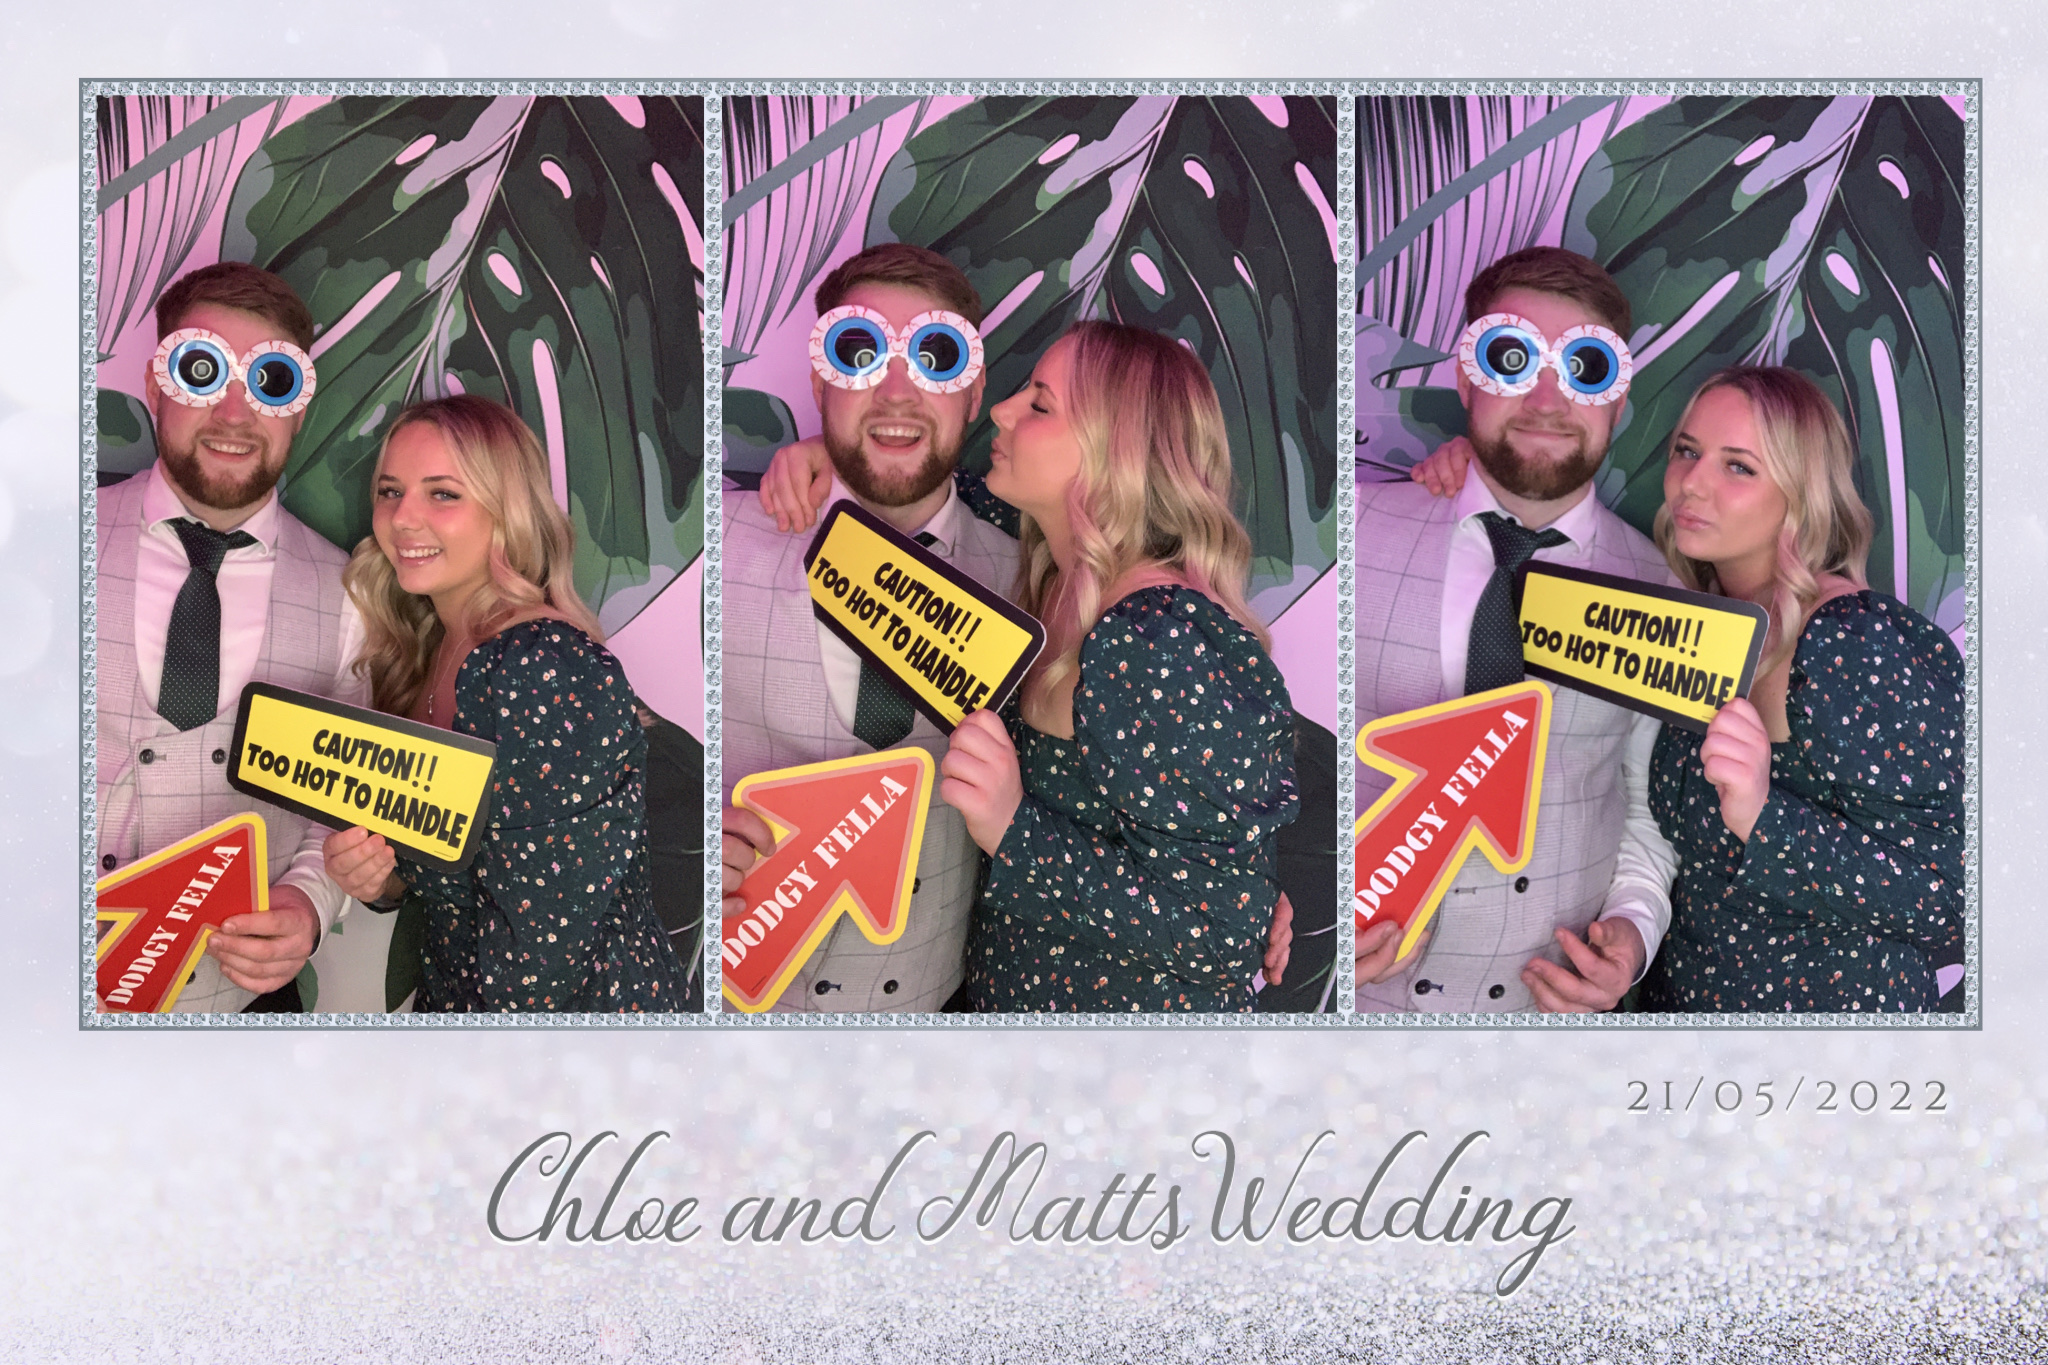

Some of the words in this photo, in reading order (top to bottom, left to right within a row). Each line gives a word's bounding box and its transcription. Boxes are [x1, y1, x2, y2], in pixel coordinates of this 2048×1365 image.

[812, 556, 851, 600] TOO
[844, 589, 888, 634] HOT
[882, 609, 908, 652] TO
[903, 634, 991, 712] HANDLE
[872, 561, 983, 653] CAUTION!!
[1583, 601, 1705, 658] CAUTION!!
[1520, 619, 1563, 653] TOO
[1563, 633, 1612, 668] HOT
[1613, 647, 1641, 680] TO
[1642, 656, 1735, 712] HANDLE
[246, 742, 291, 778] TOO
[291, 758, 341, 797] HOT
[342, 776, 371, 810] TO
[372, 787, 469, 850] HANDLE
[312, 728, 439, 793] CAUTION!!
[1355, 802, 1448, 922] DODGY
[1440, 709, 1529, 807] FELLA
[105, 925, 179, 1005] DODGY
[165, 844, 242, 923] FELLA
[722, 861, 819, 970] DODGY
[812, 774, 908, 871] FELLA
